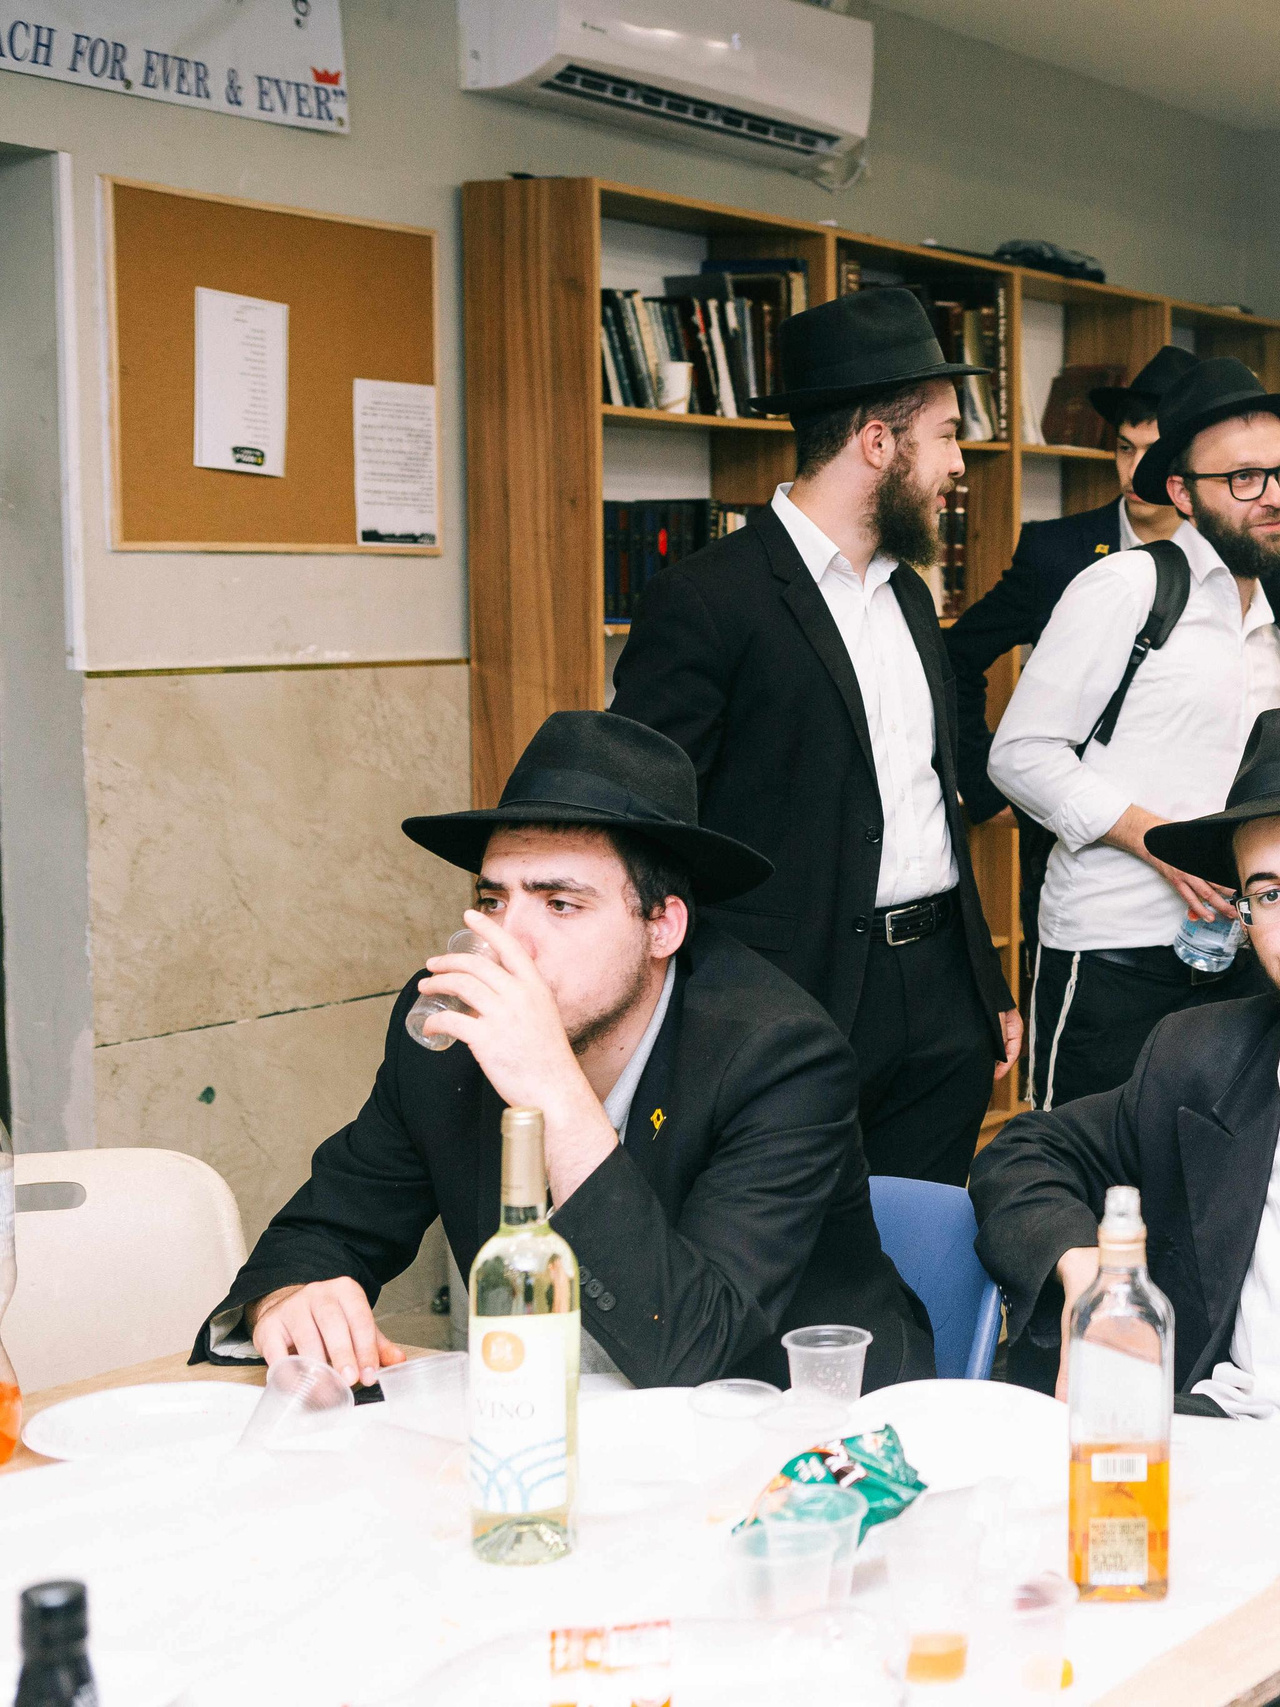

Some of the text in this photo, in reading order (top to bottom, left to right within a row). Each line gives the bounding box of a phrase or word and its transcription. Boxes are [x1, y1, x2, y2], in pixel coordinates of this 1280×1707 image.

[0, 20, 57, 67] CH
[67, 33, 128, 81] FOR
[141, 49, 210, 99] EVER
[225, 67, 243, 106] &
[475, 1396, 536, 1420] VINO
